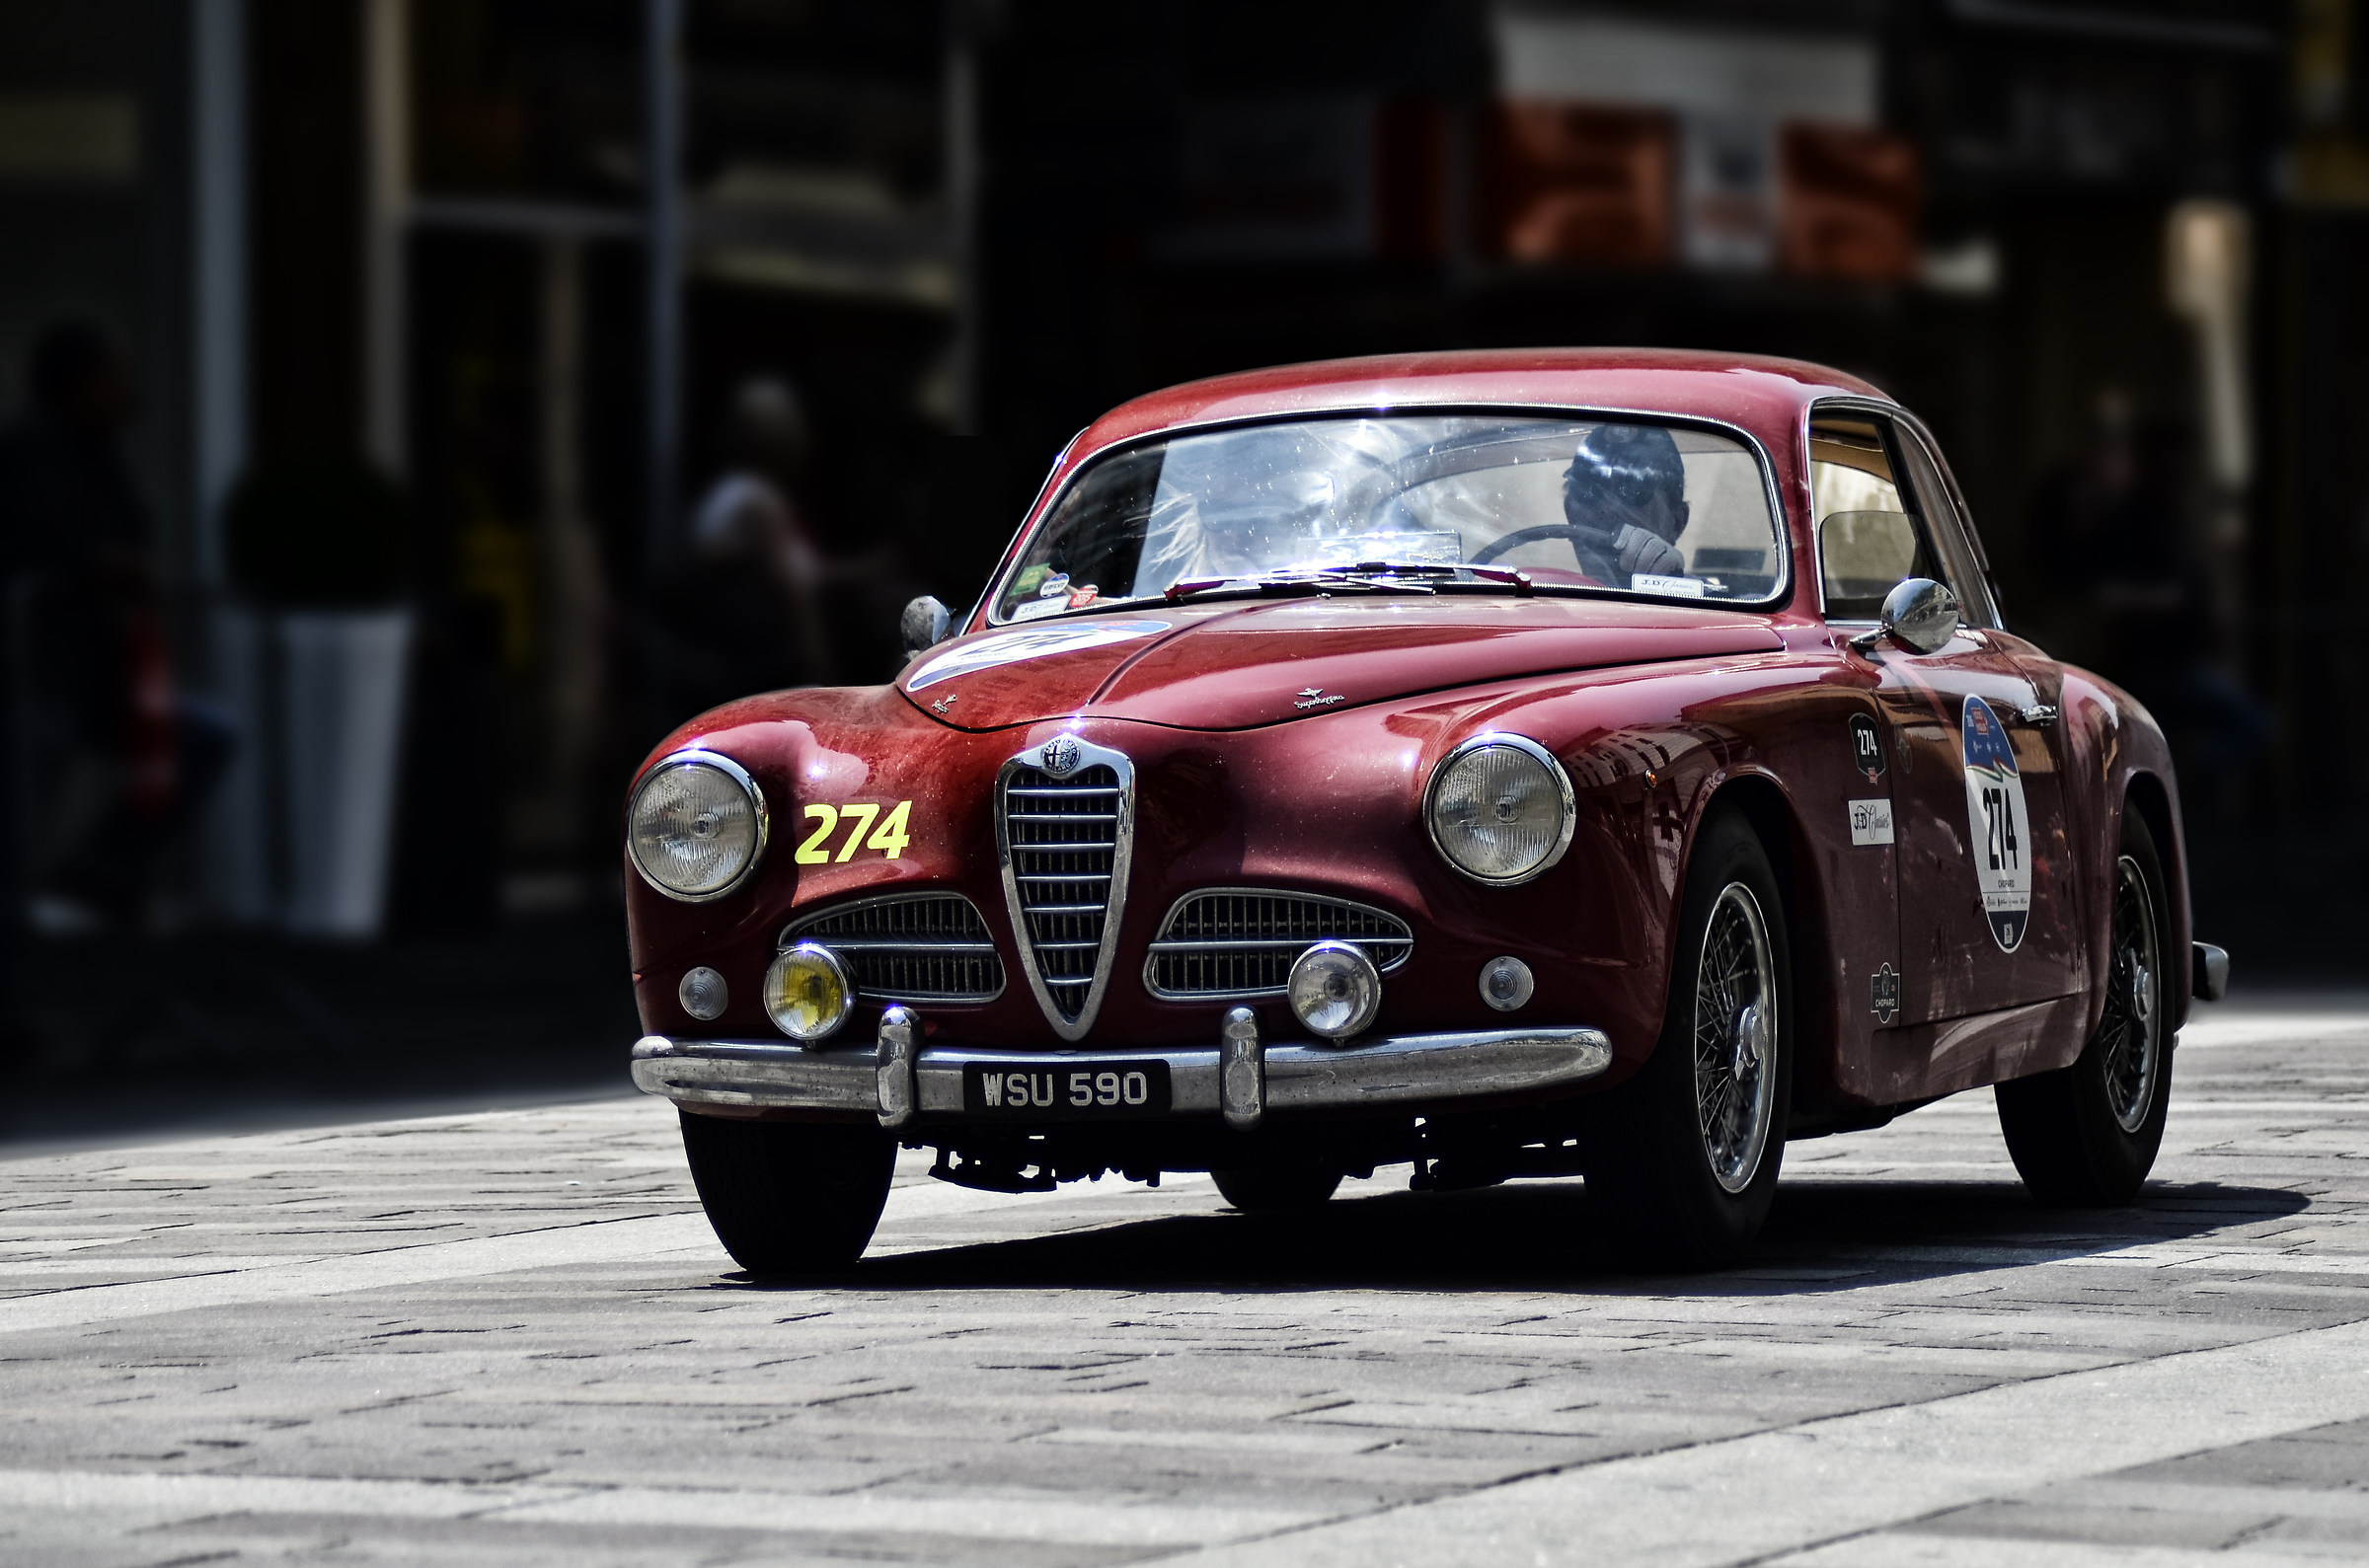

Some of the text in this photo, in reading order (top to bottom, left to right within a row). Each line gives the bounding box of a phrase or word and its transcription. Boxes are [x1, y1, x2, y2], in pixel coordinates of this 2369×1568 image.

[1857, 729, 1877, 756] 274
[795, 800, 913, 864] 274
[1982, 786, 2019, 870] 274
[982, 1072, 1147, 1107] WSU 590
